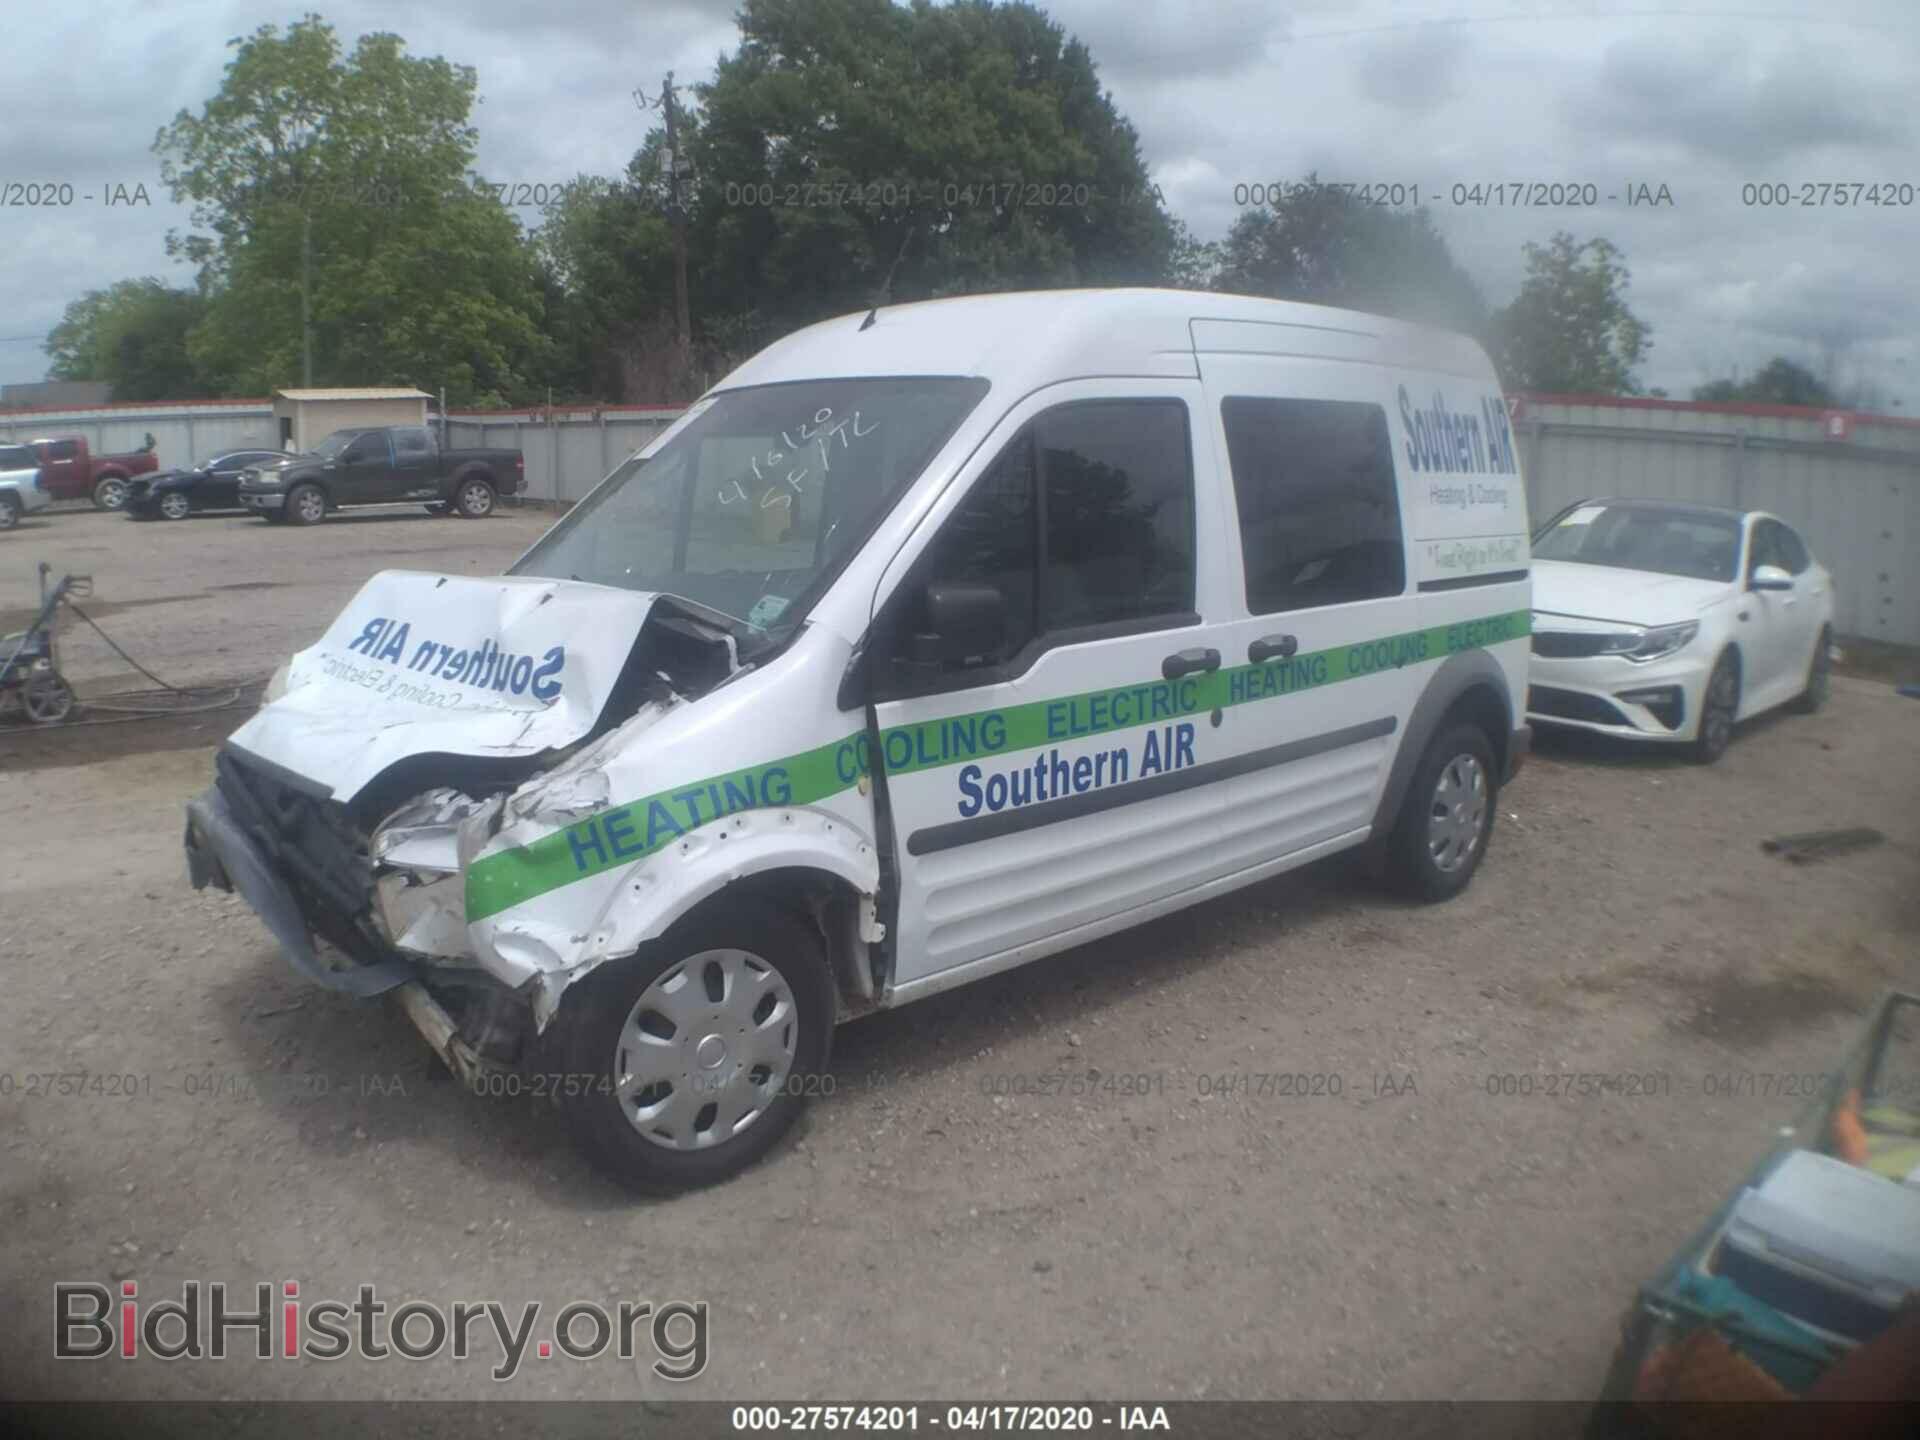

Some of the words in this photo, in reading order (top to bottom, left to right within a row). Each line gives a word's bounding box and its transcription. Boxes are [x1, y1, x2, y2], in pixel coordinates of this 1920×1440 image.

[1398, 383, 1485, 473] Southern
[1481, 396, 1517, 474] AIR
[566, 768, 792, 871] HEATING
[837, 714, 1006, 784] COOLING
[1047, 679, 1197, 739] ELECTRIC
[1230, 655, 1326, 702] HEATING
[1347, 633, 1427, 674] COOLING
[1449, 616, 1513, 650] ELECTRIC
[957, 748, 1128, 818] Southern
[1140, 723, 1195, 777] AIR
